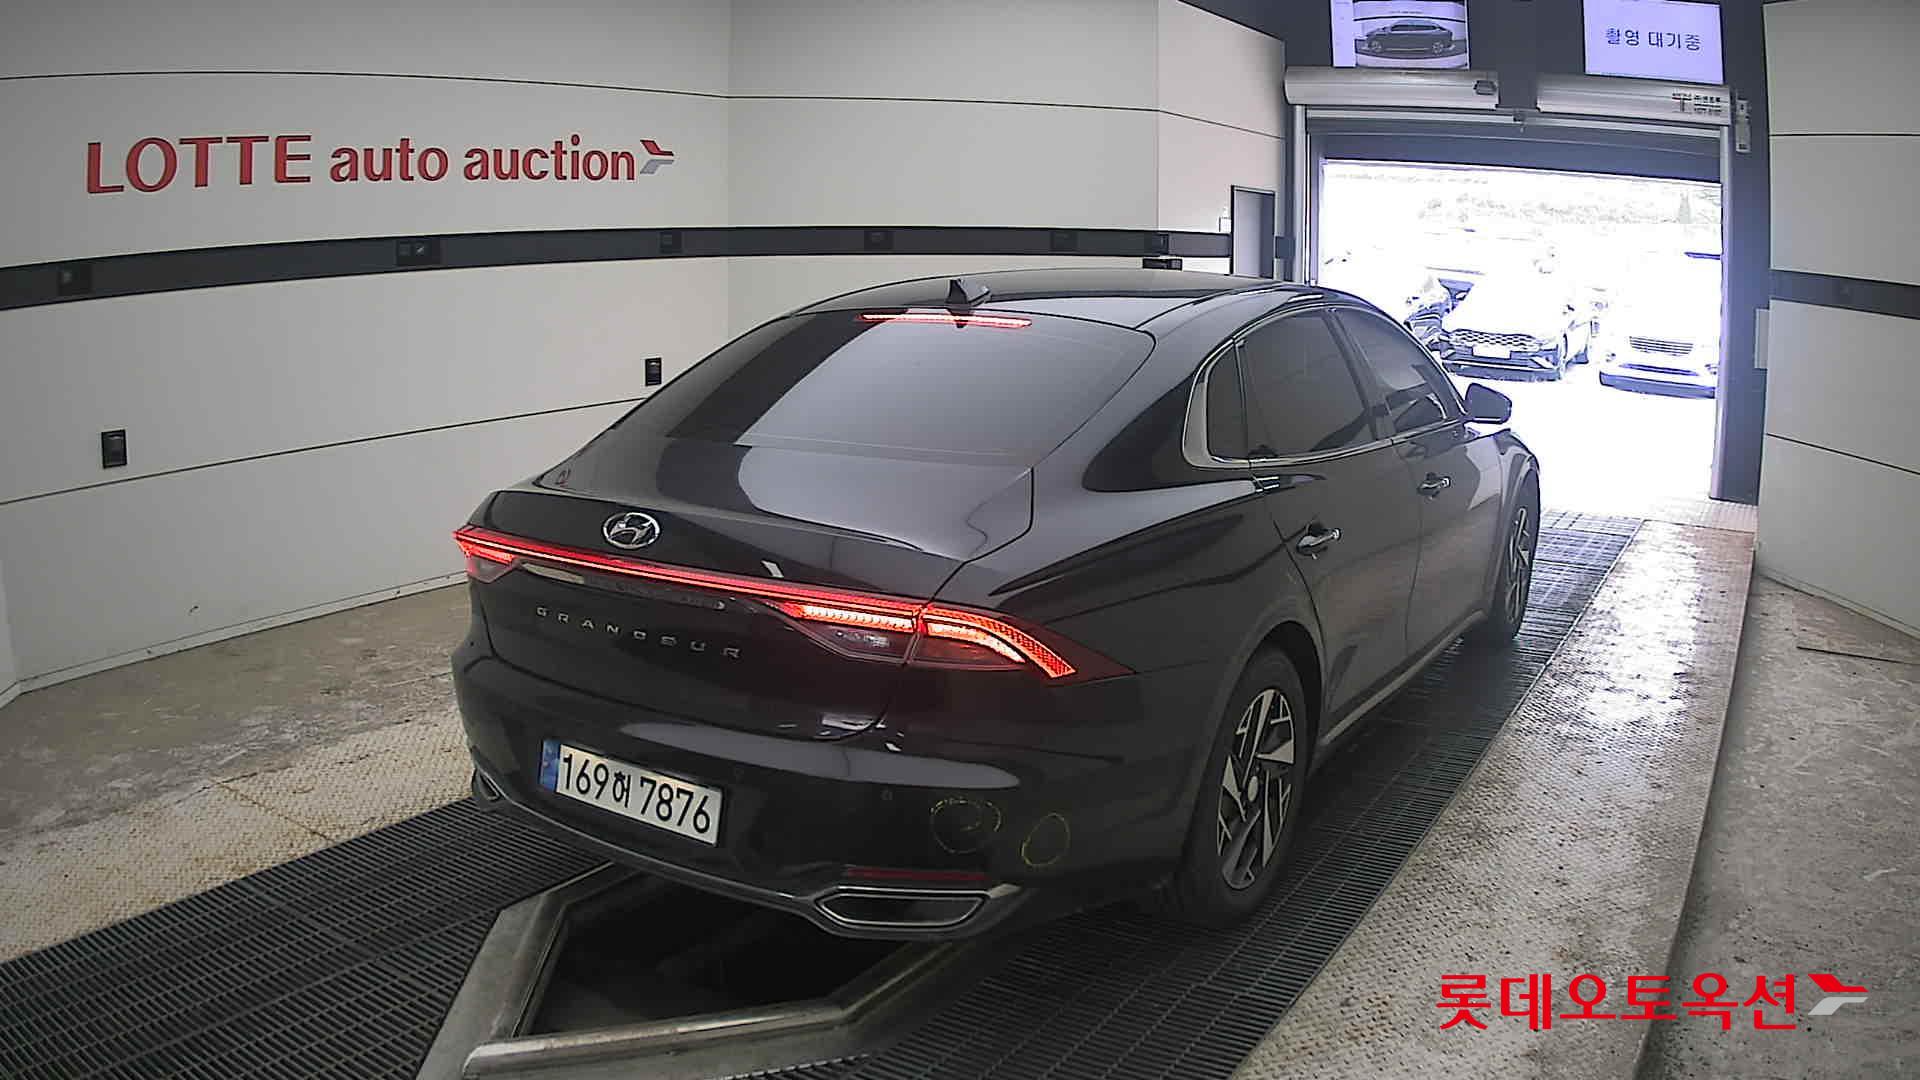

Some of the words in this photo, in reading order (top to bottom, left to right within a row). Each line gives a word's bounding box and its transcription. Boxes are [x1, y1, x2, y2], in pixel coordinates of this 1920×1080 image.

[1648, 31, 1701, 51] 대기중
[86, 134, 312, 194] LOTTE
[330, 137, 449, 183] auto
[463, 133, 636, 181] auction
[536, 606, 742, 659] GRANDEUR
[639, 775, 711, 835] 7876
